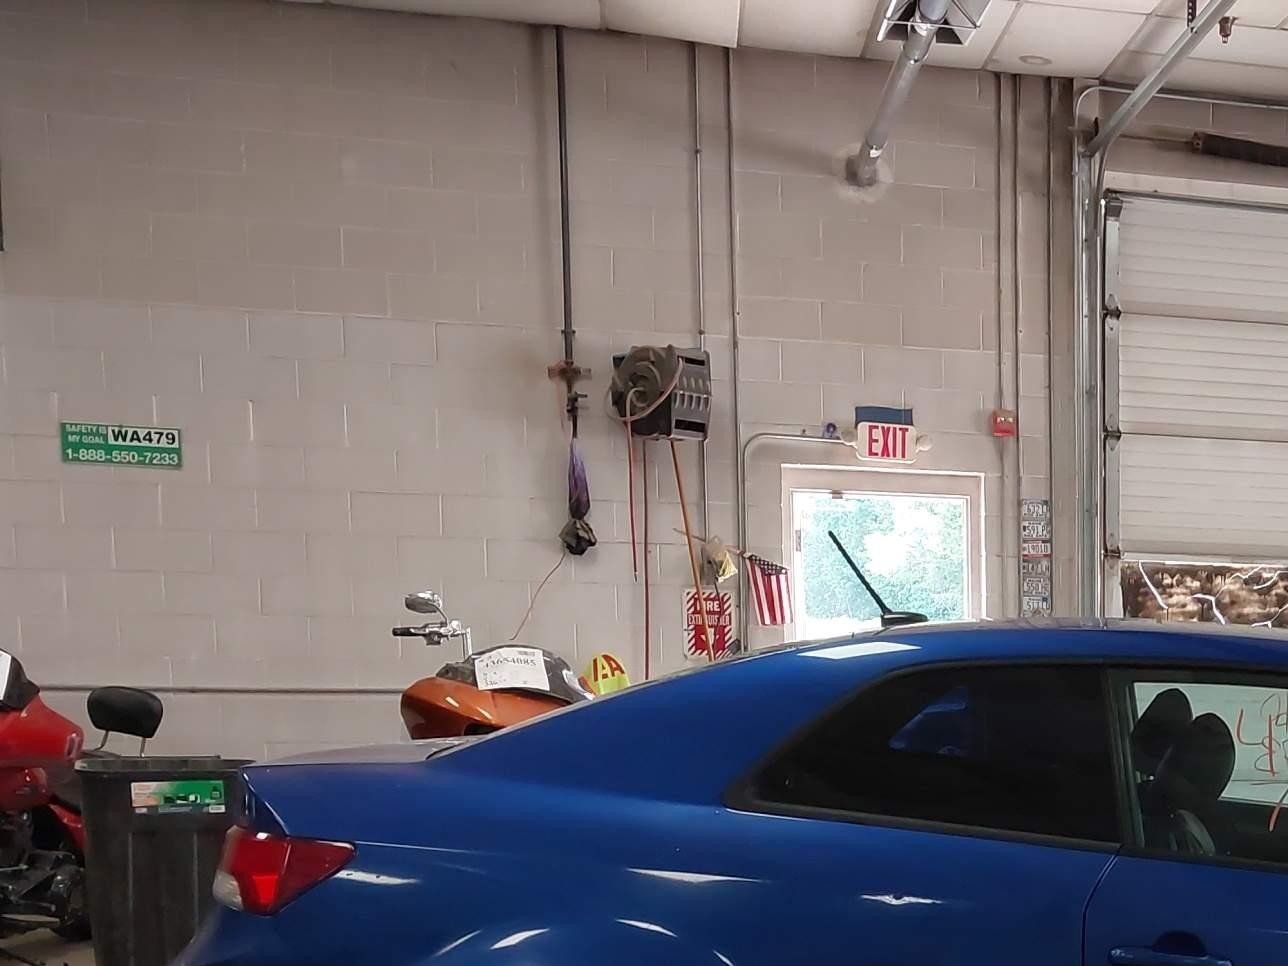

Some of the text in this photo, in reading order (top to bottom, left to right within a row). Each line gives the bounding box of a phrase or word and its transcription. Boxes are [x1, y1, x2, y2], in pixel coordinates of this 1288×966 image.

[65, 424, 107, 434] SAFETY IS
[68, 435, 105, 444] MY GOAL
[110, 429, 176, 446] WA479
[868, 425, 909, 459] EXIT
[65, 448, 178, 465] 1-888-550-7233
[697, 600, 720, 611] RE
